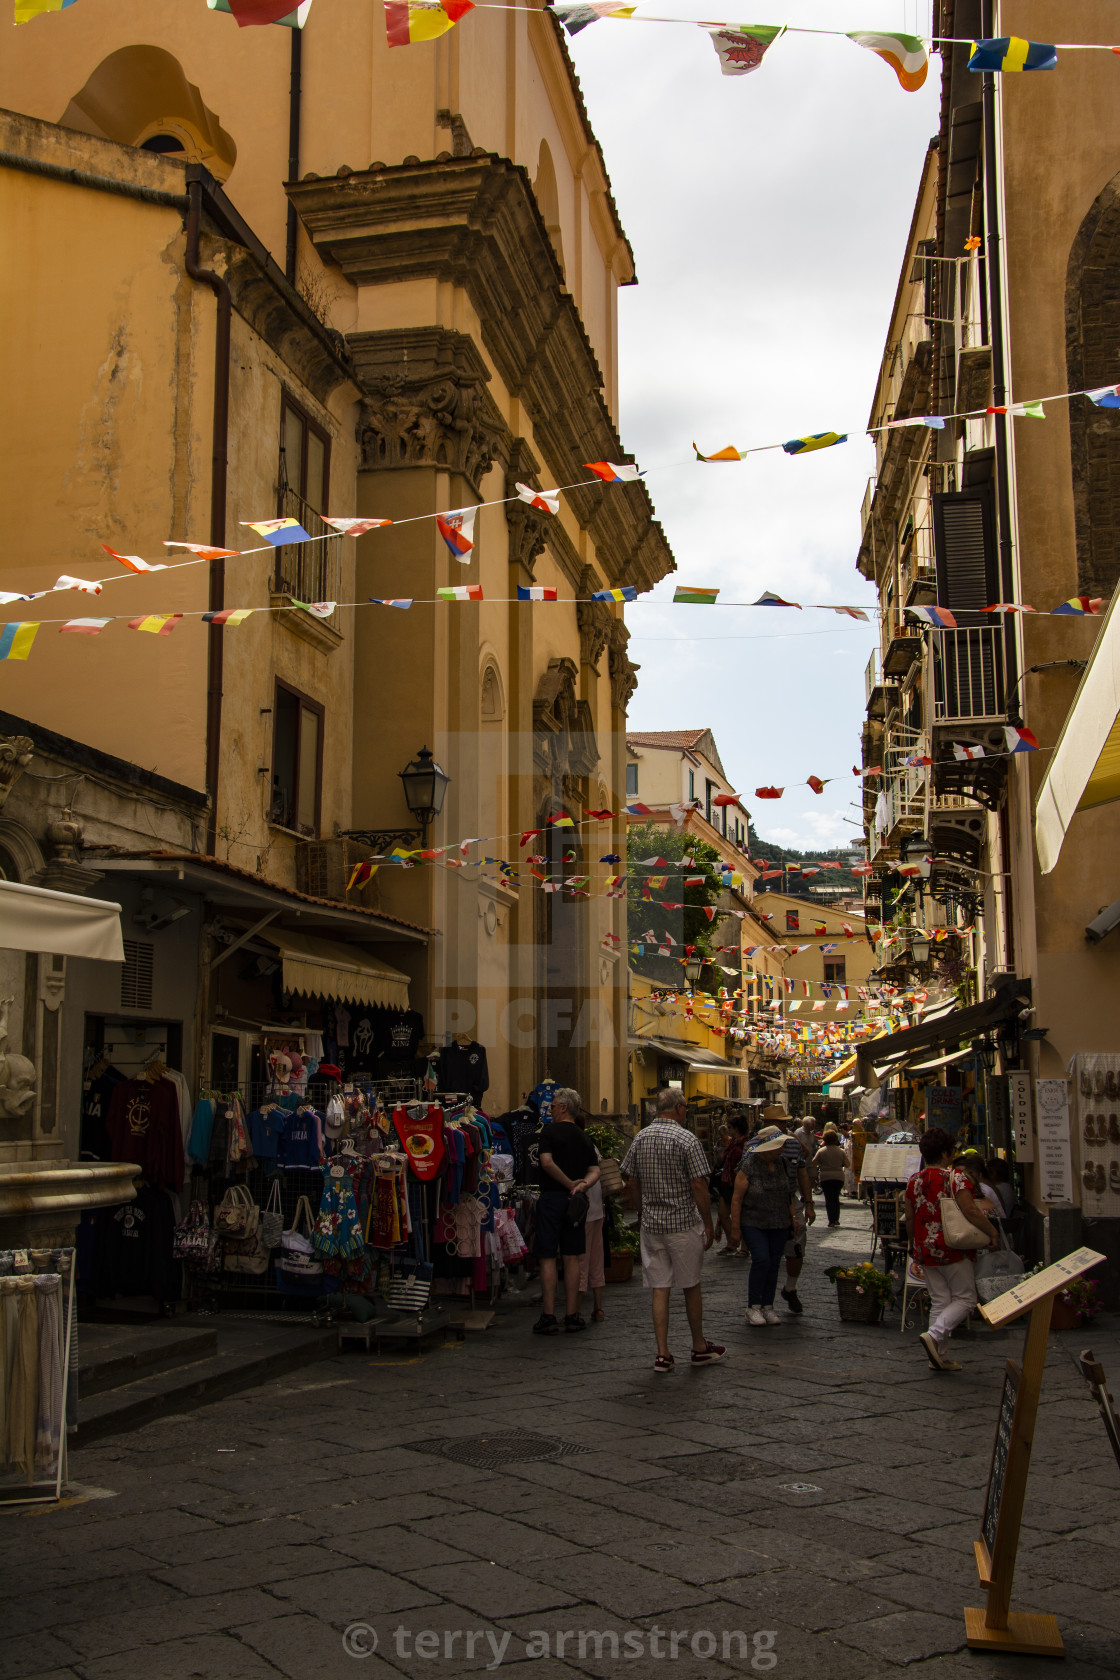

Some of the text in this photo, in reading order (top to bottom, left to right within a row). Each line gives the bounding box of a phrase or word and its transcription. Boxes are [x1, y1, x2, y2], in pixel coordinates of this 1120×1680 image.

[931, 1088, 956, 1097] COLD
[931, 1097, 960, 1106] DRINKS
[1017, 1080, 1027, 1146] COLD DRINK
